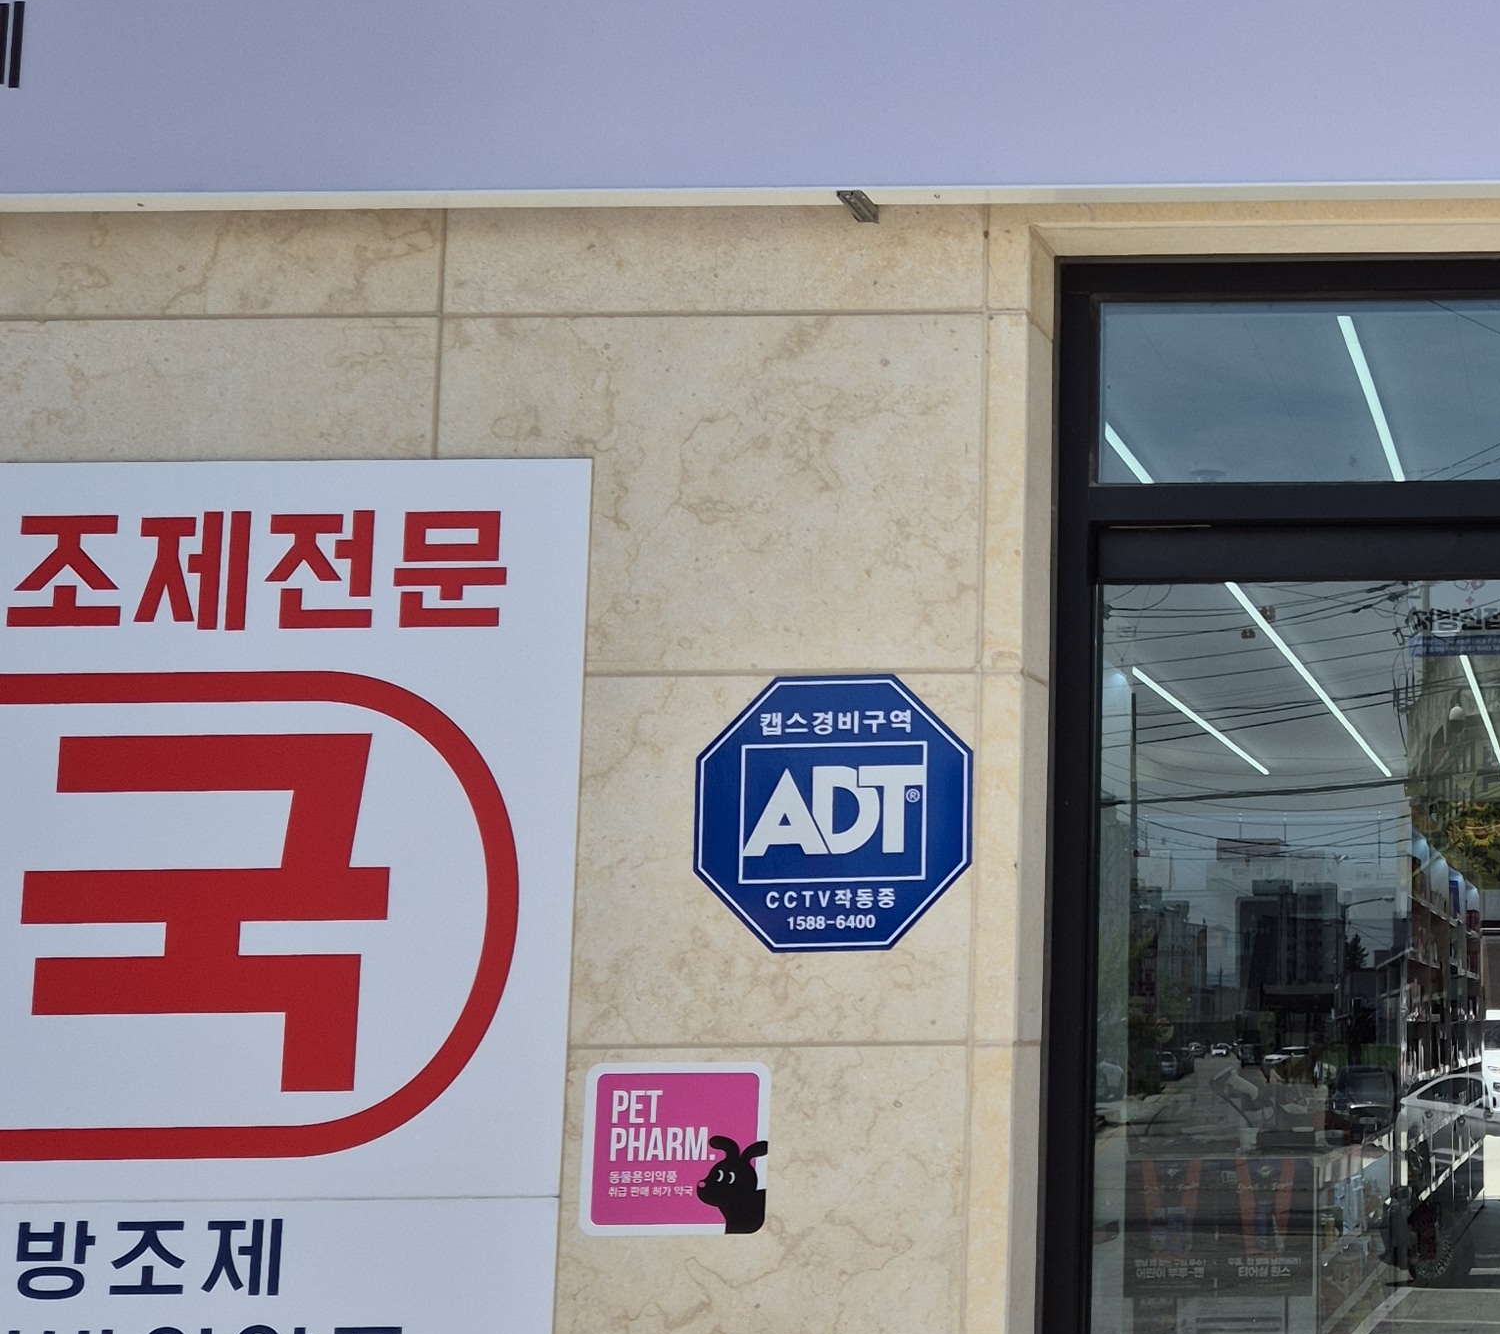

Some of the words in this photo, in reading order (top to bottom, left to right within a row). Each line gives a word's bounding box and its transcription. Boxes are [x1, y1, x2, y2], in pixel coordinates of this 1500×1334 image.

[6, 509, 508, 631] 조제전문
[760, 709, 912, 736] 캡스경비구역
[741, 764, 927, 857] ADT
[20, 733, 390, 1092] 국
[765, 887, 896, 909] CCTV작동중
[786, 914, 876, 930] 1588-6400
[611, 1089, 664, 1124] PET
[609, 1127, 716, 1161] PHARM.
[608, 1186, 627, 1198] 취급
[630, 1186, 649, 1197] 판매
[674, 1185, 694, 1196] 약국
[609, 1170, 677, 1184] 동물용의약품
[15, 1218, 284, 1301] 방조제
